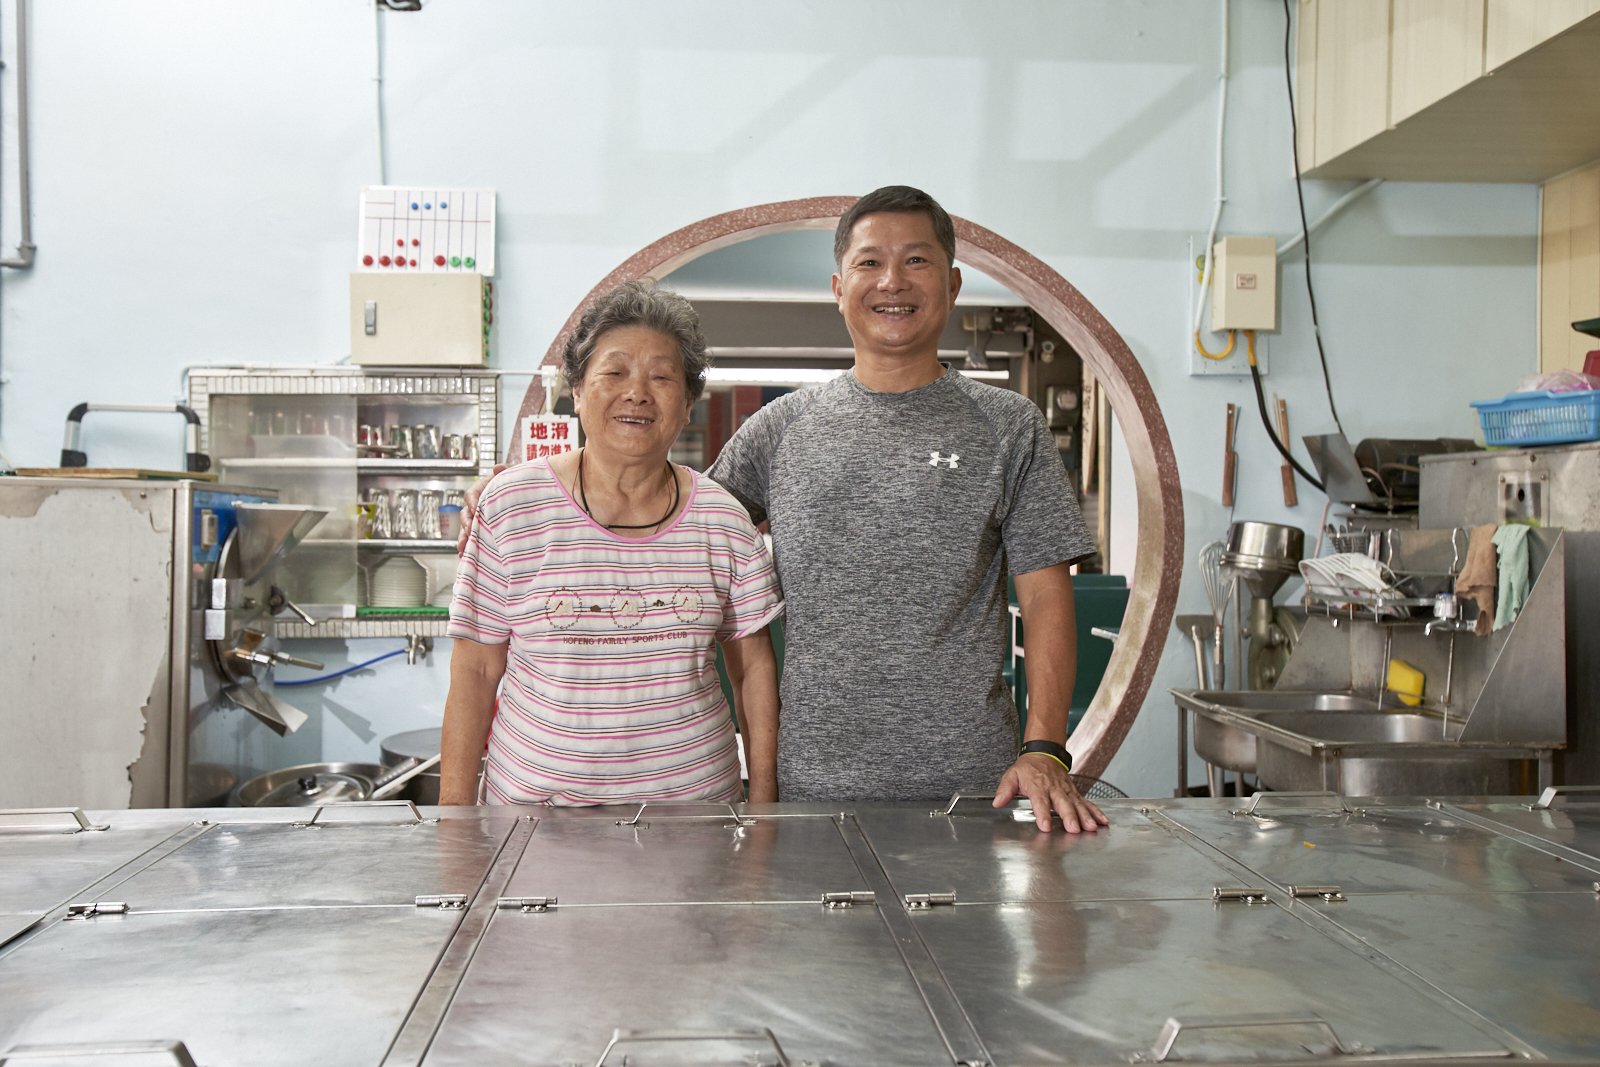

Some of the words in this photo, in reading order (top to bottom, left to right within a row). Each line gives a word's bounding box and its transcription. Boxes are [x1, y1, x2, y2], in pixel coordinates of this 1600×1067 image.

[530, 422, 569, 440] 地滑
[632, 633, 664, 643] SPORTS
[666, 631, 688, 640] CLUB
